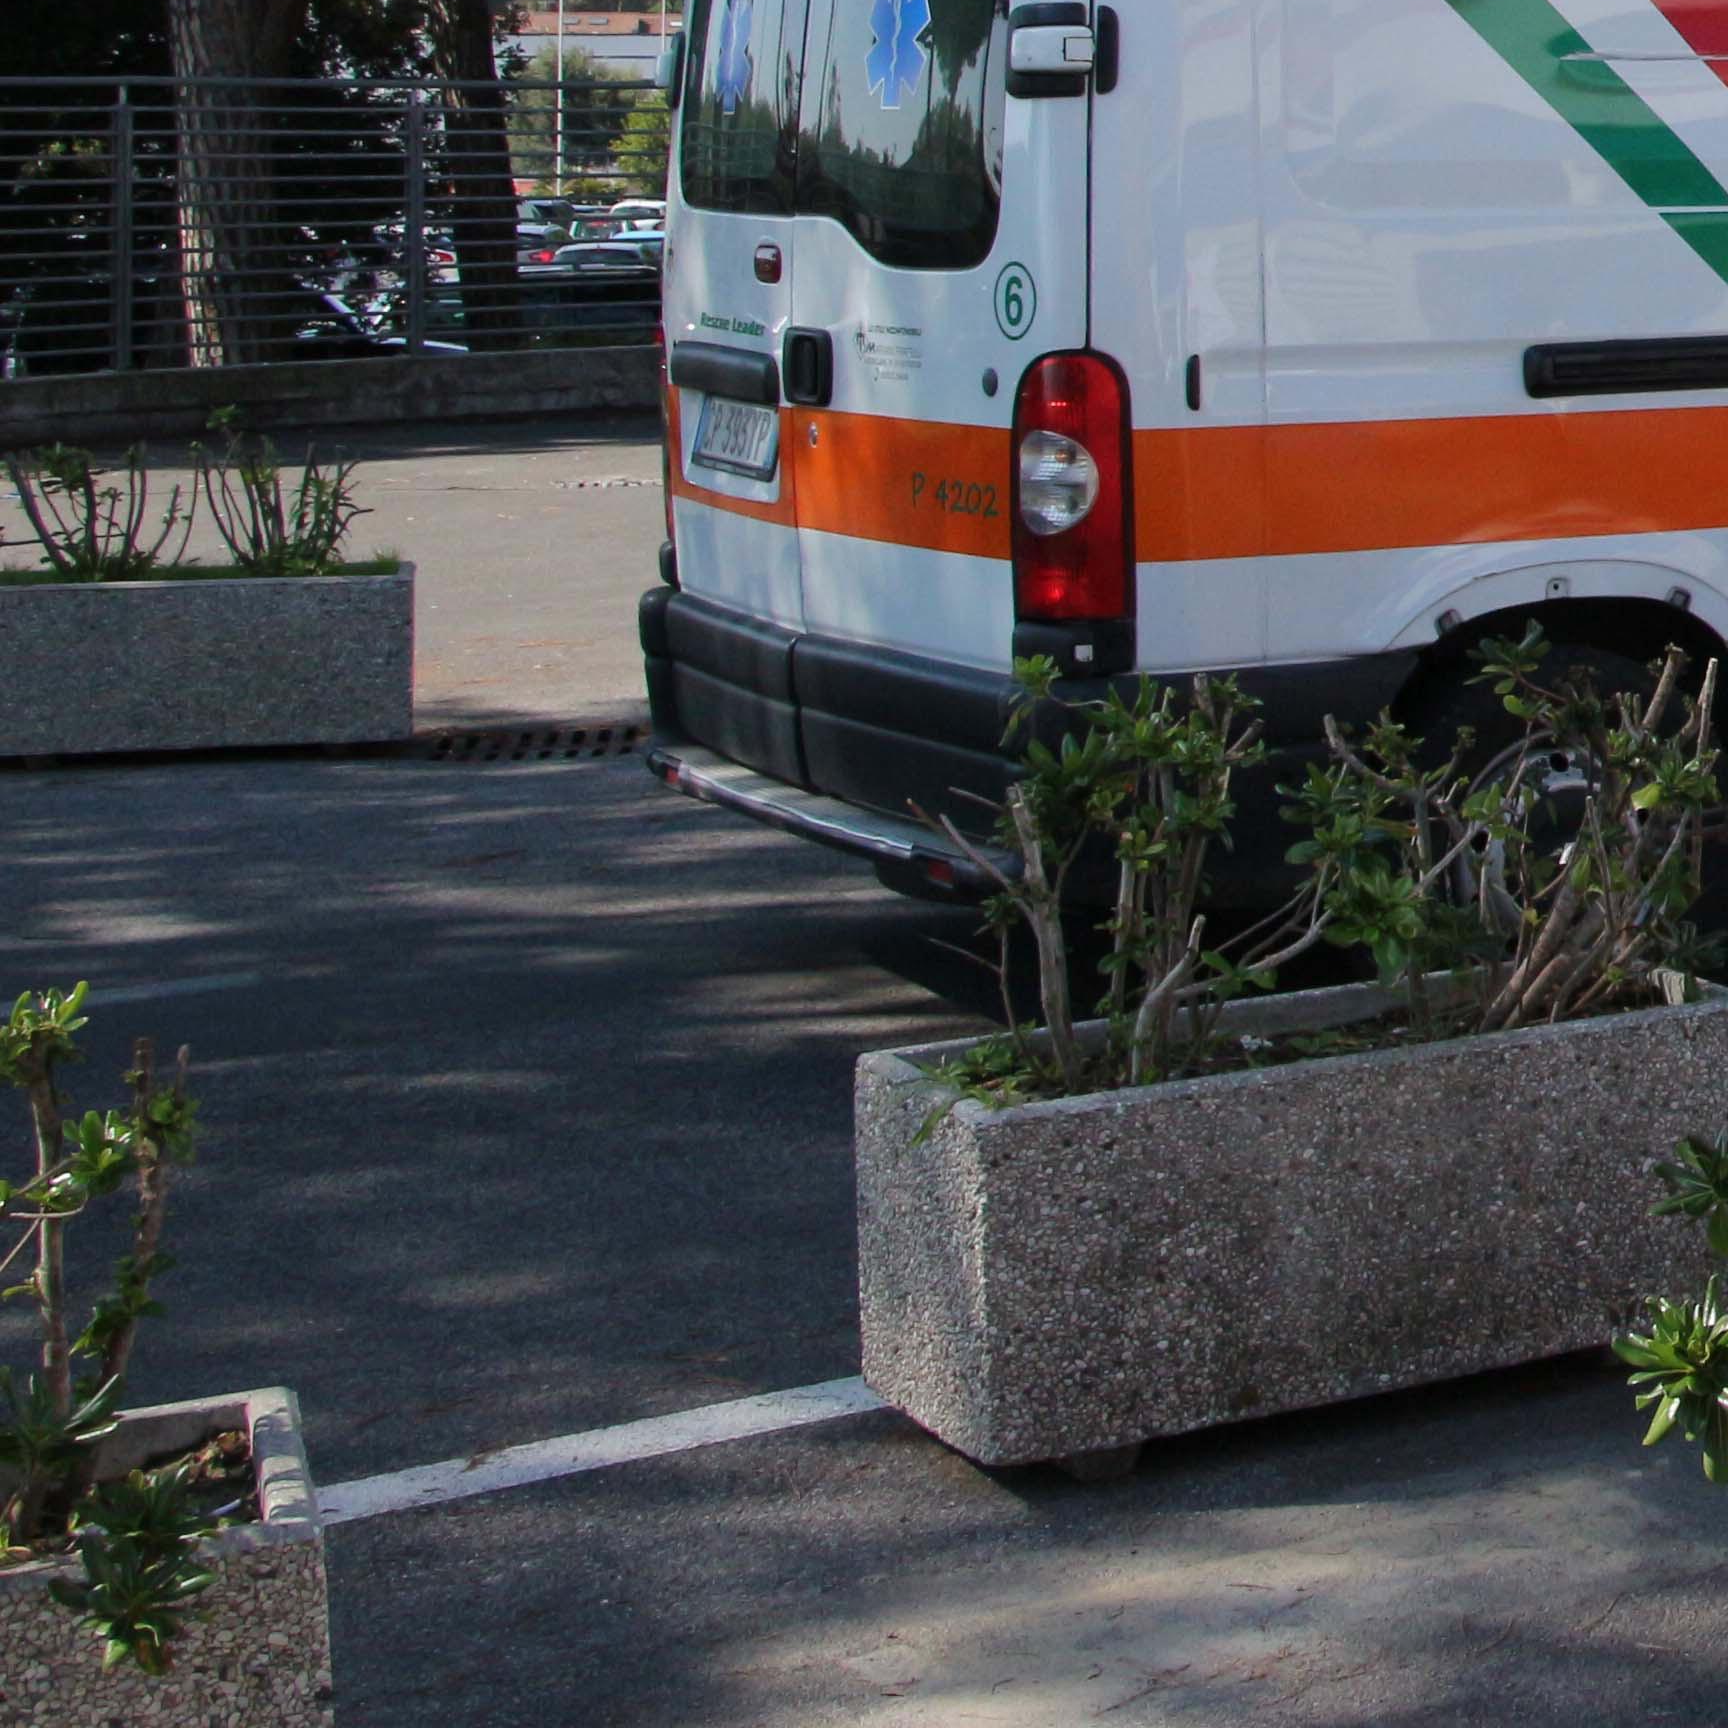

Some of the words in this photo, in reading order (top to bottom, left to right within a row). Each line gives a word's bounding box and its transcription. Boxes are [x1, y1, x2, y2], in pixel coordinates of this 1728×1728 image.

[1005, 275, 1023, 326] 6
[911, 471, 926, 507] P
[935, 479, 999, 518] 4202
